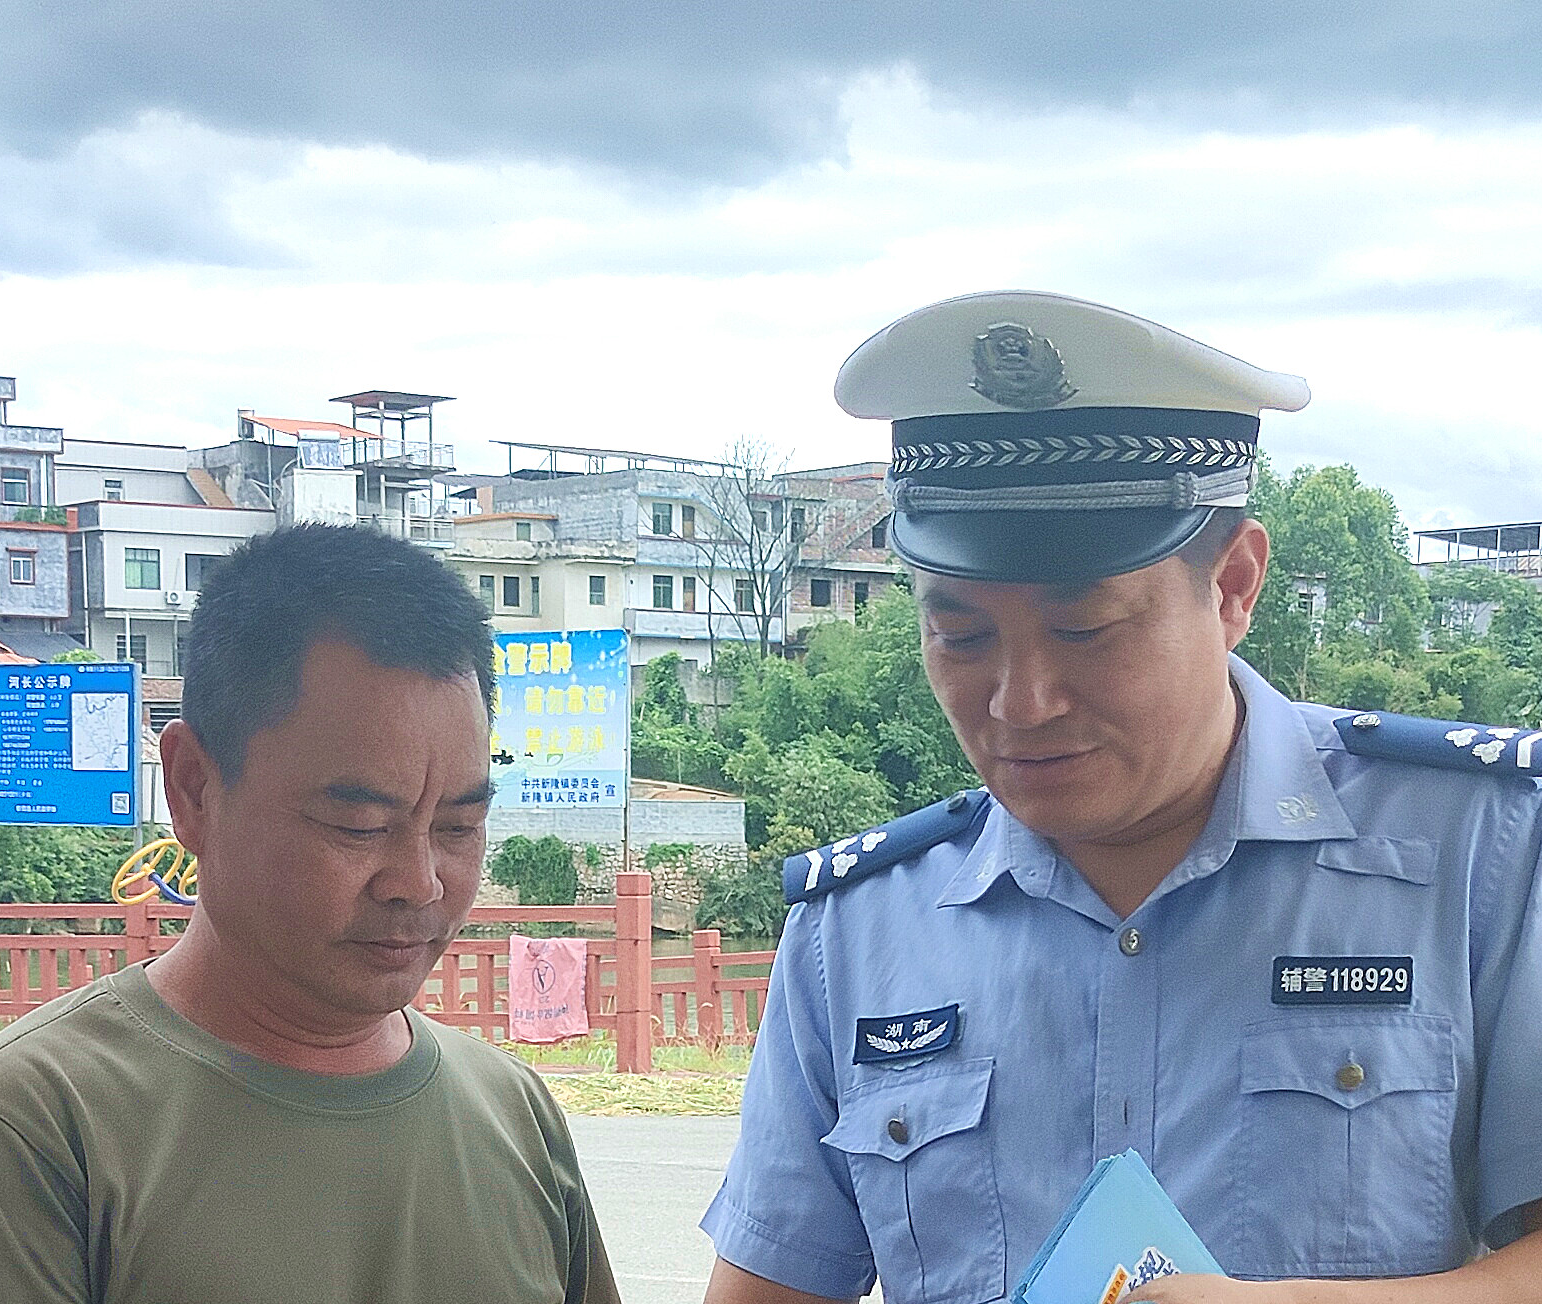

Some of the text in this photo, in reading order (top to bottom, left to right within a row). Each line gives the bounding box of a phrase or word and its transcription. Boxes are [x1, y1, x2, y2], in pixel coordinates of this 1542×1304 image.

[9, 675, 72, 690] 河长公示牌
[521, 777, 600, 790] 中共新隆镇委员会
[521, 791, 600, 803] 新隆镇人民政府
[1280, 967, 1408, 992] 辅警118929
